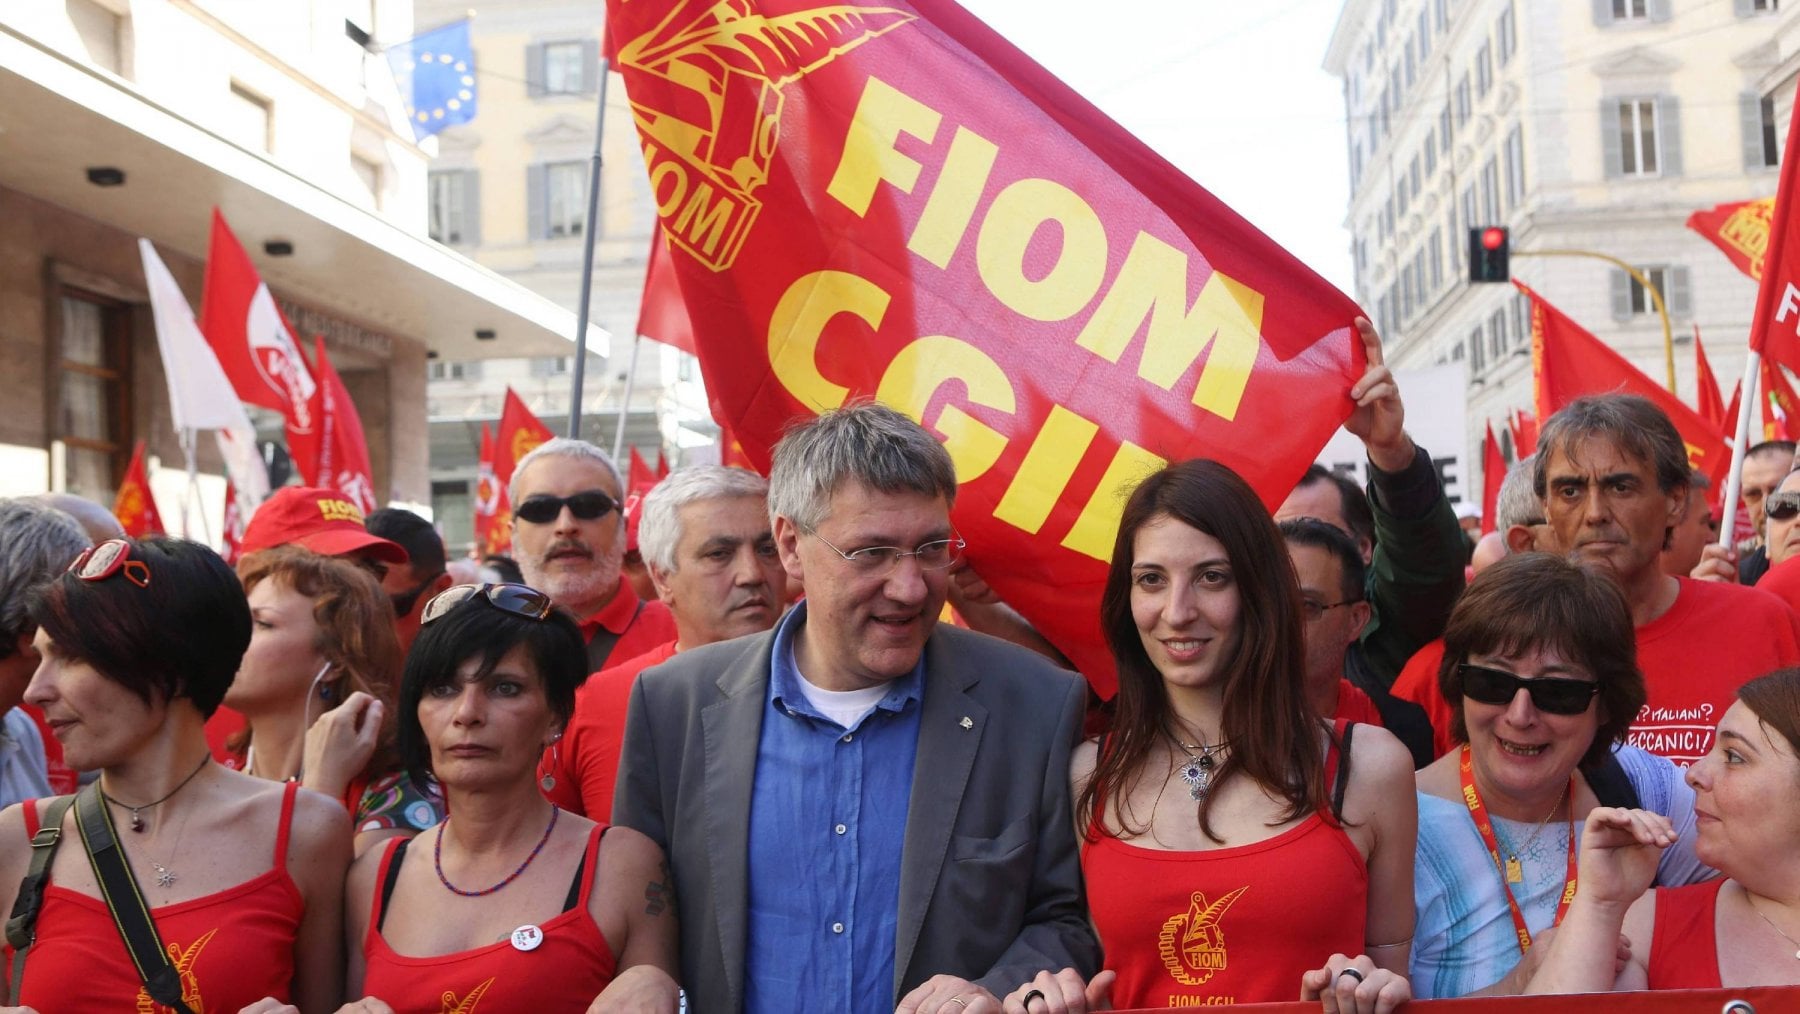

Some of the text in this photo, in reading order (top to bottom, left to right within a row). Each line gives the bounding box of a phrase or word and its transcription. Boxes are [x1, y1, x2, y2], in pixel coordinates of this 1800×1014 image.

[826, 75, 1265, 421] FIOM
[1652, 703, 1713, 722] ITALIANI?
[1624, 731, 1710, 754] ECCANICI!
[1464, 784, 1480, 811] FIOM
[1191, 952, 1223, 968] FIOM
